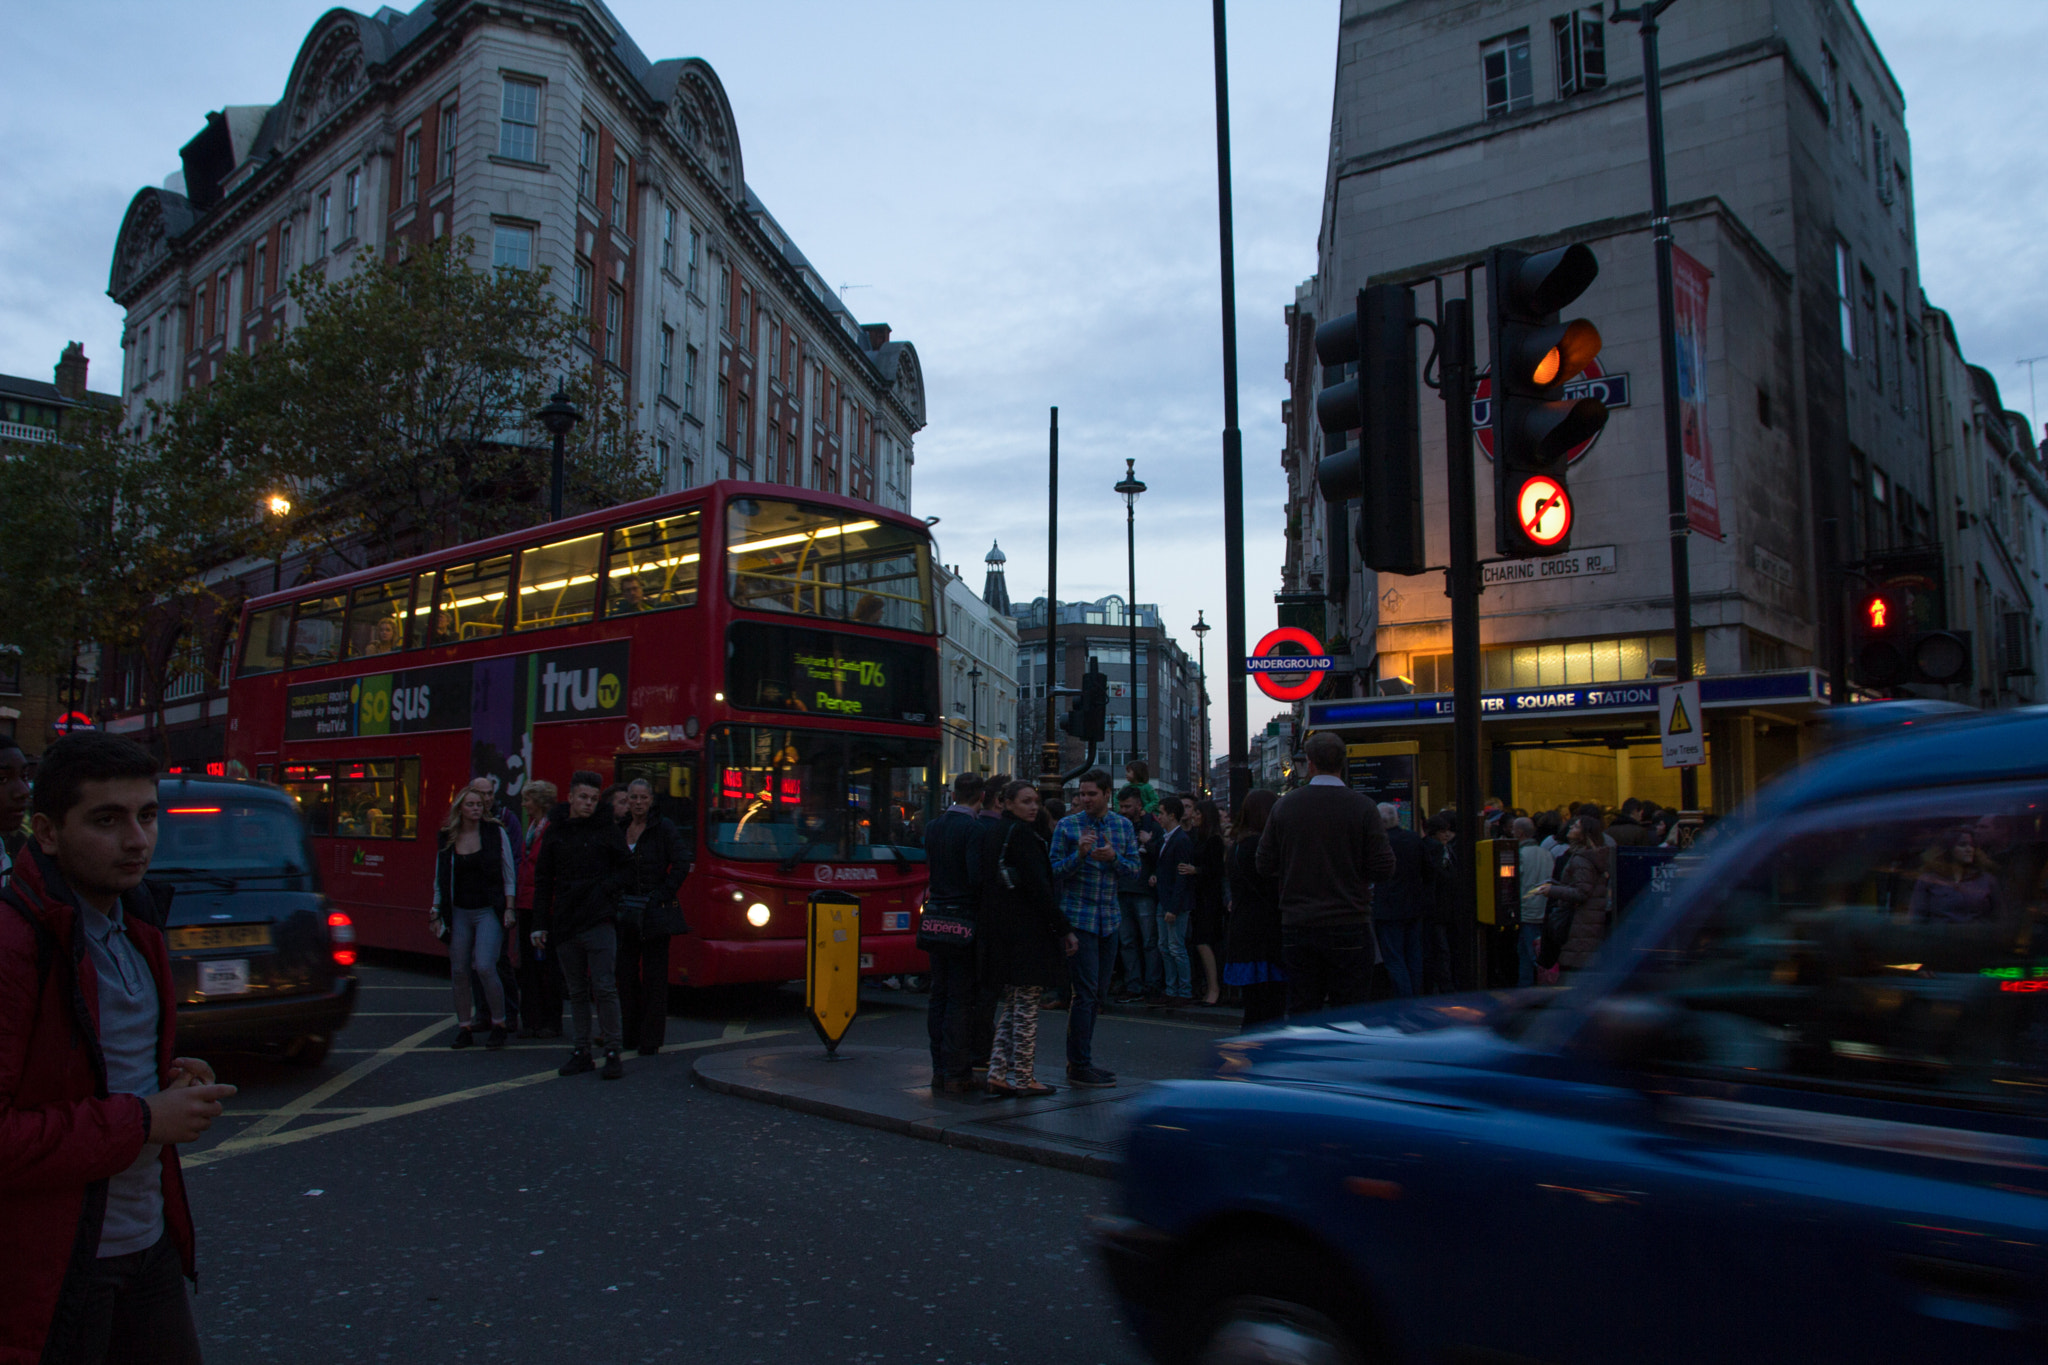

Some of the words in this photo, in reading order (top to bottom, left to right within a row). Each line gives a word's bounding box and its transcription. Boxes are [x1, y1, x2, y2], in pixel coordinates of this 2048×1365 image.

[1484, 564, 1534, 582] CHARING
[1541, 558, 1579, 576] CROSS
[860, 661, 886, 688] 176
[1246, 658, 1331, 669] UNDERGROUND
[542, 661, 599, 712] tru
[600, 684, 618, 701] TV
[816, 691, 863, 715] Penge
[1435, 698, 1505, 714] LEITER
[1516, 692, 1576, 709] SQUARE
[1587, 688, 1651, 705] STATION
[642, 724, 687, 743] ARRIVA
[1665, 747, 1678, 757] Low
[1679, 744, 1699, 755] Trees
[833, 867, 879, 881] ARRIVA
